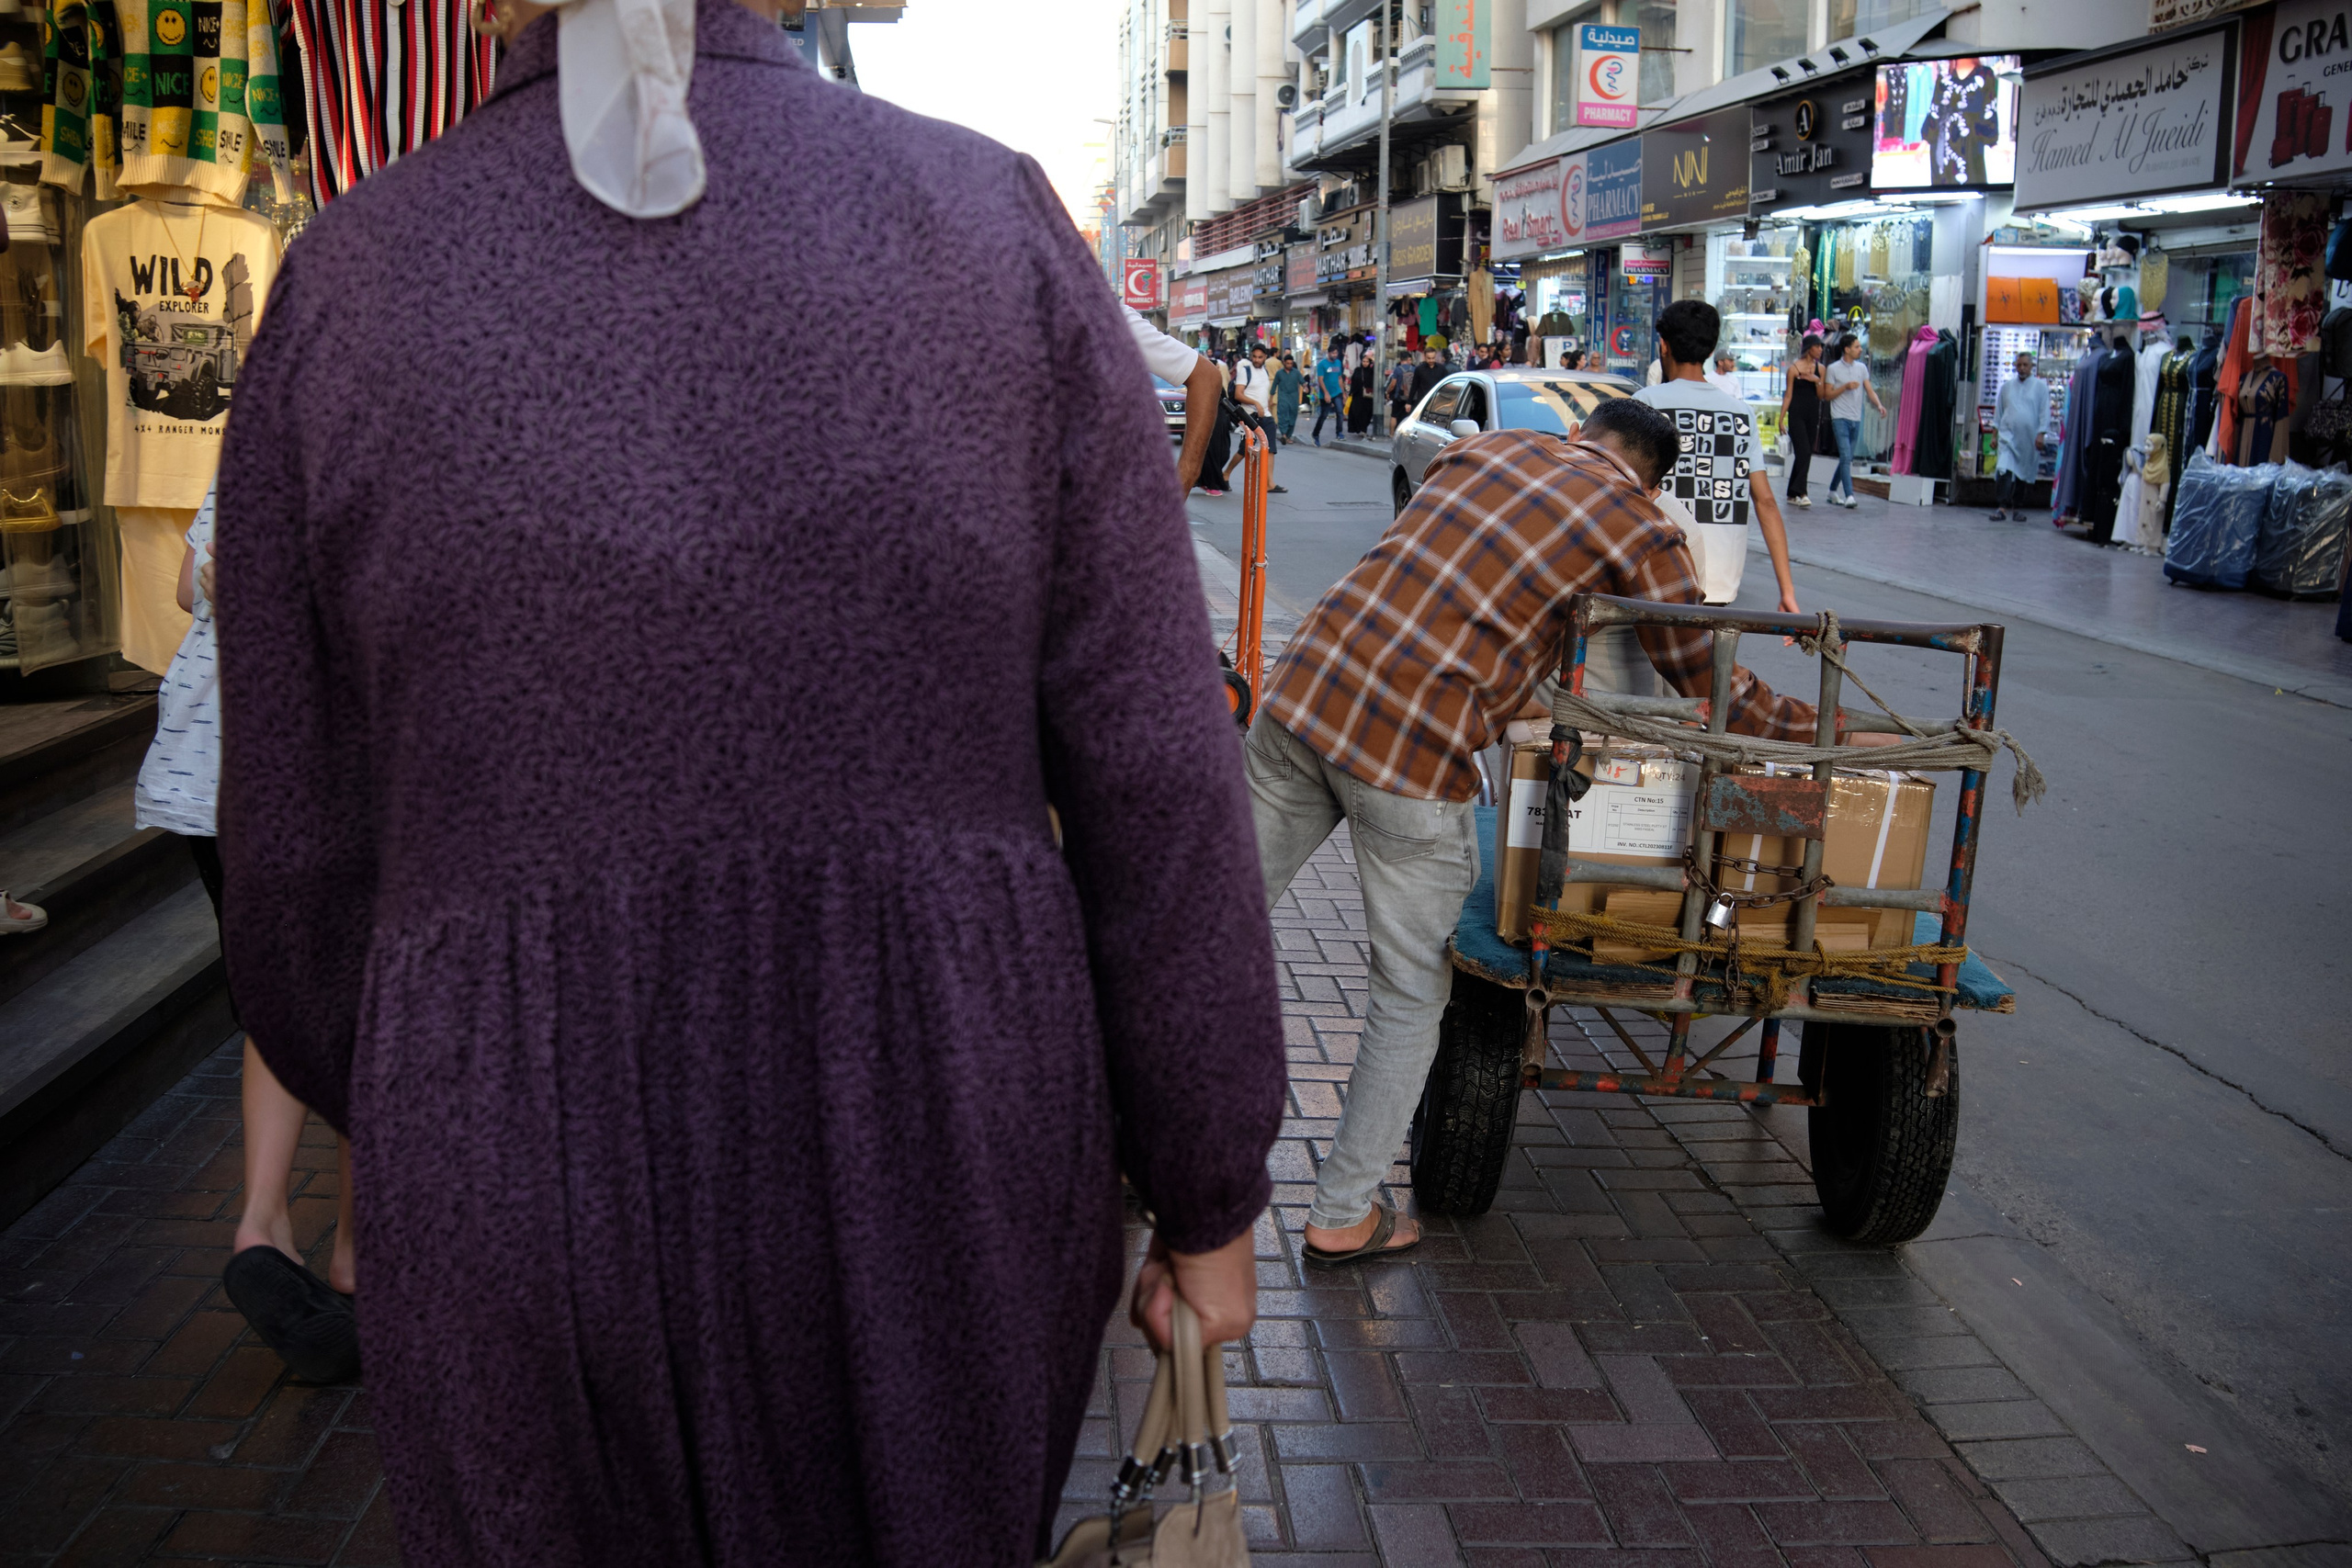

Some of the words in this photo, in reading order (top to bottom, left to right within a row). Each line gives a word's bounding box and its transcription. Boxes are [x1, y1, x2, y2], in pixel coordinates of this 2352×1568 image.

[1449, 0, 1482, 79] ندقية
[1587, 28, 1635, 49] صيدلية
[1584, 106, 1633, 122] PHARMACY
[2027, 120, 2101, 175] Hamed
[2099, 111, 2138, 163] Al
[1775, 147, 1807, 175] Amir
[1808, 143, 1833, 173] Jan
[1588, 158, 1642, 187] صيدلية
[1587, 183, 1642, 222] PHARMACY
[1503, 215, 1521, 243] Real
[130, 254, 213, 296] WILD
[1253, 265, 1280, 287] MATHAR
[1316, 251, 1347, 276] MATHAR
[160, 300, 209, 313] EXPLORER
[1608, 357, 1638, 368] PHARMACY
[134, 424, 152, 434] 4X4
[159, 425, 194, 434] RANGER
[1655, 772, 1686, 783] QTY:24
